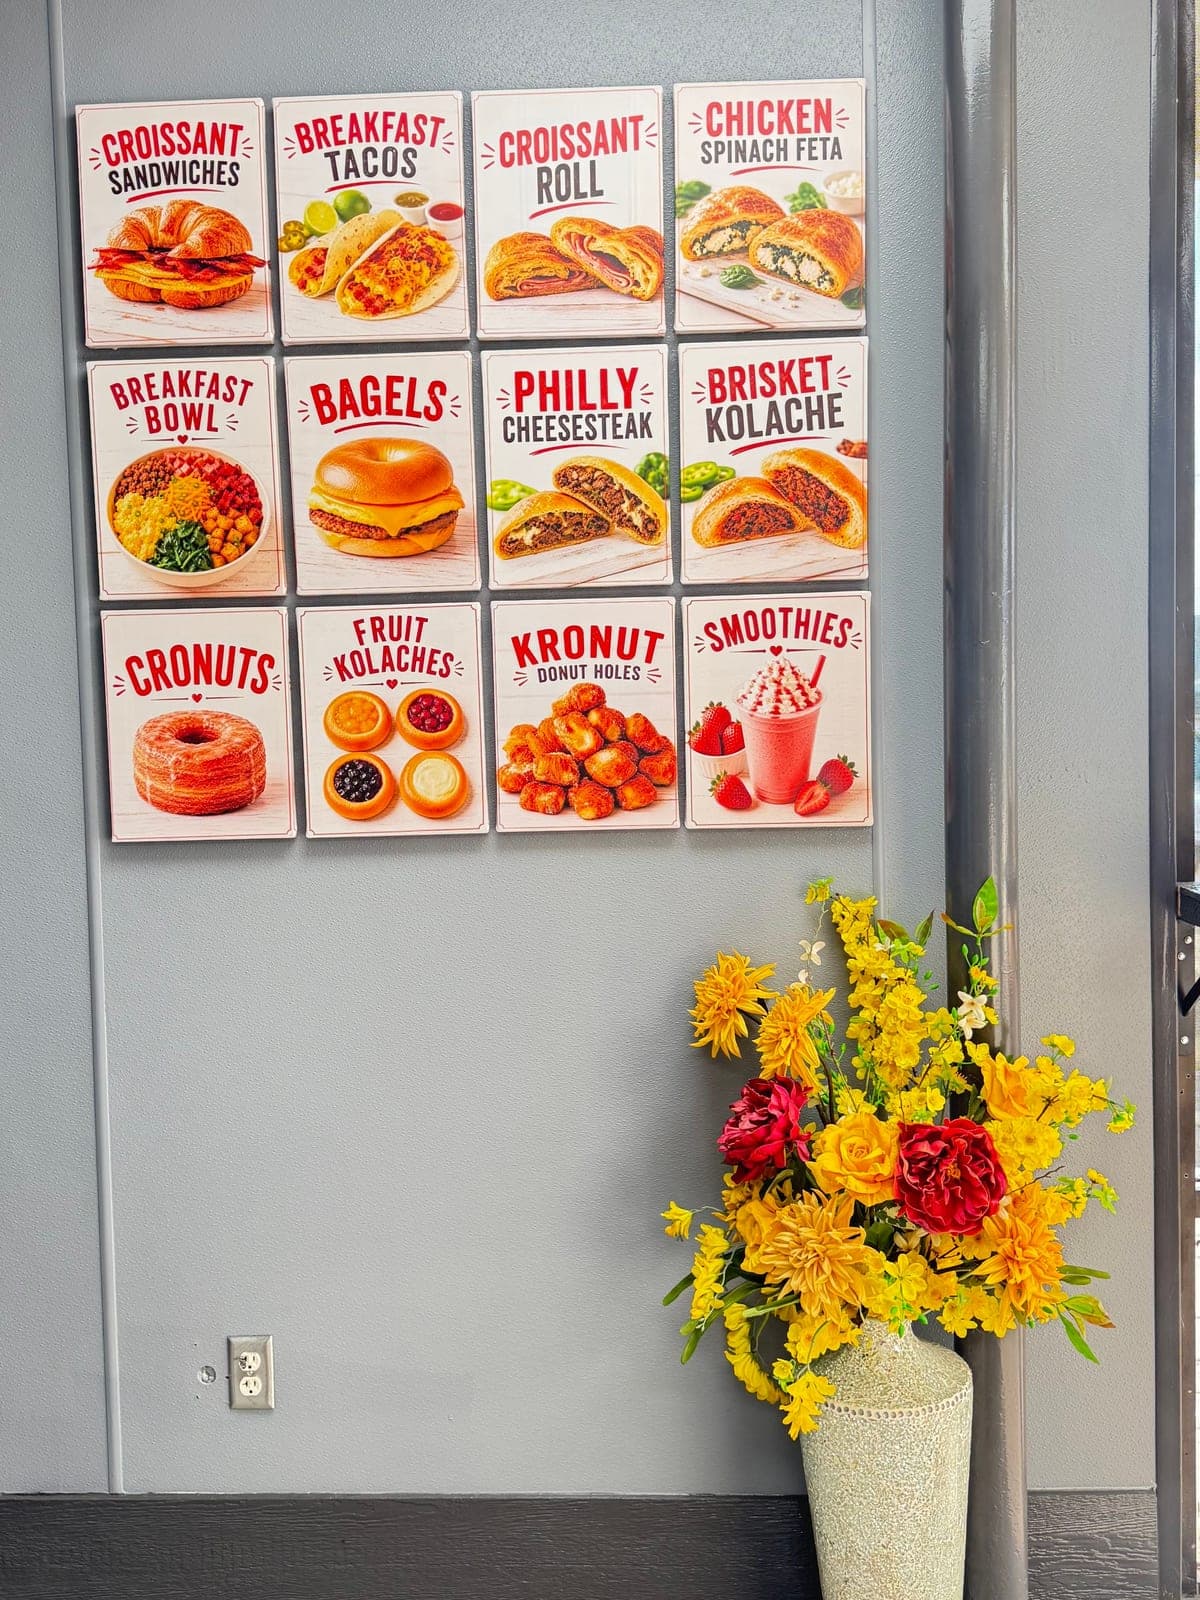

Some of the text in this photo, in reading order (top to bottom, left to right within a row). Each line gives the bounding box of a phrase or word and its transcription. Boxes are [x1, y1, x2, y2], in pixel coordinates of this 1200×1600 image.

[294, 111, 445, 153] BREAKFAST
[705, 98, 832, 137] CHICKEN
[101, 121, 244, 167] CROISSANT
[499, 115, 643, 168] CROISSANT
[700, 137, 842, 165] SPINACH FETA
[108, 160, 240, 195] SANDWICHES
[324, 146, 418, 182] TACOS
[537, 159, 604, 205] ROLL
[109, 370, 254, 410] BREAKFAST
[310, 375, 447, 425] BAGELS
[514, 367, 639, 413] PHILLY
[708, 355, 833, 404] BRISKET
[145, 402, 219, 434] BOWL
[503, 412, 653, 443] CHEESESTEAK
[706, 392, 844, 443] KOLACHE
[353, 615, 429, 646] FRUIT
[511, 624, 665, 669] KRONUT
[703, 607, 854, 652] SMOOTHIES
[125, 643, 275, 697] CRONUTS
[333, 645, 455, 682] KOLACHES
[537, 664, 641, 683] DONUT HOLES
